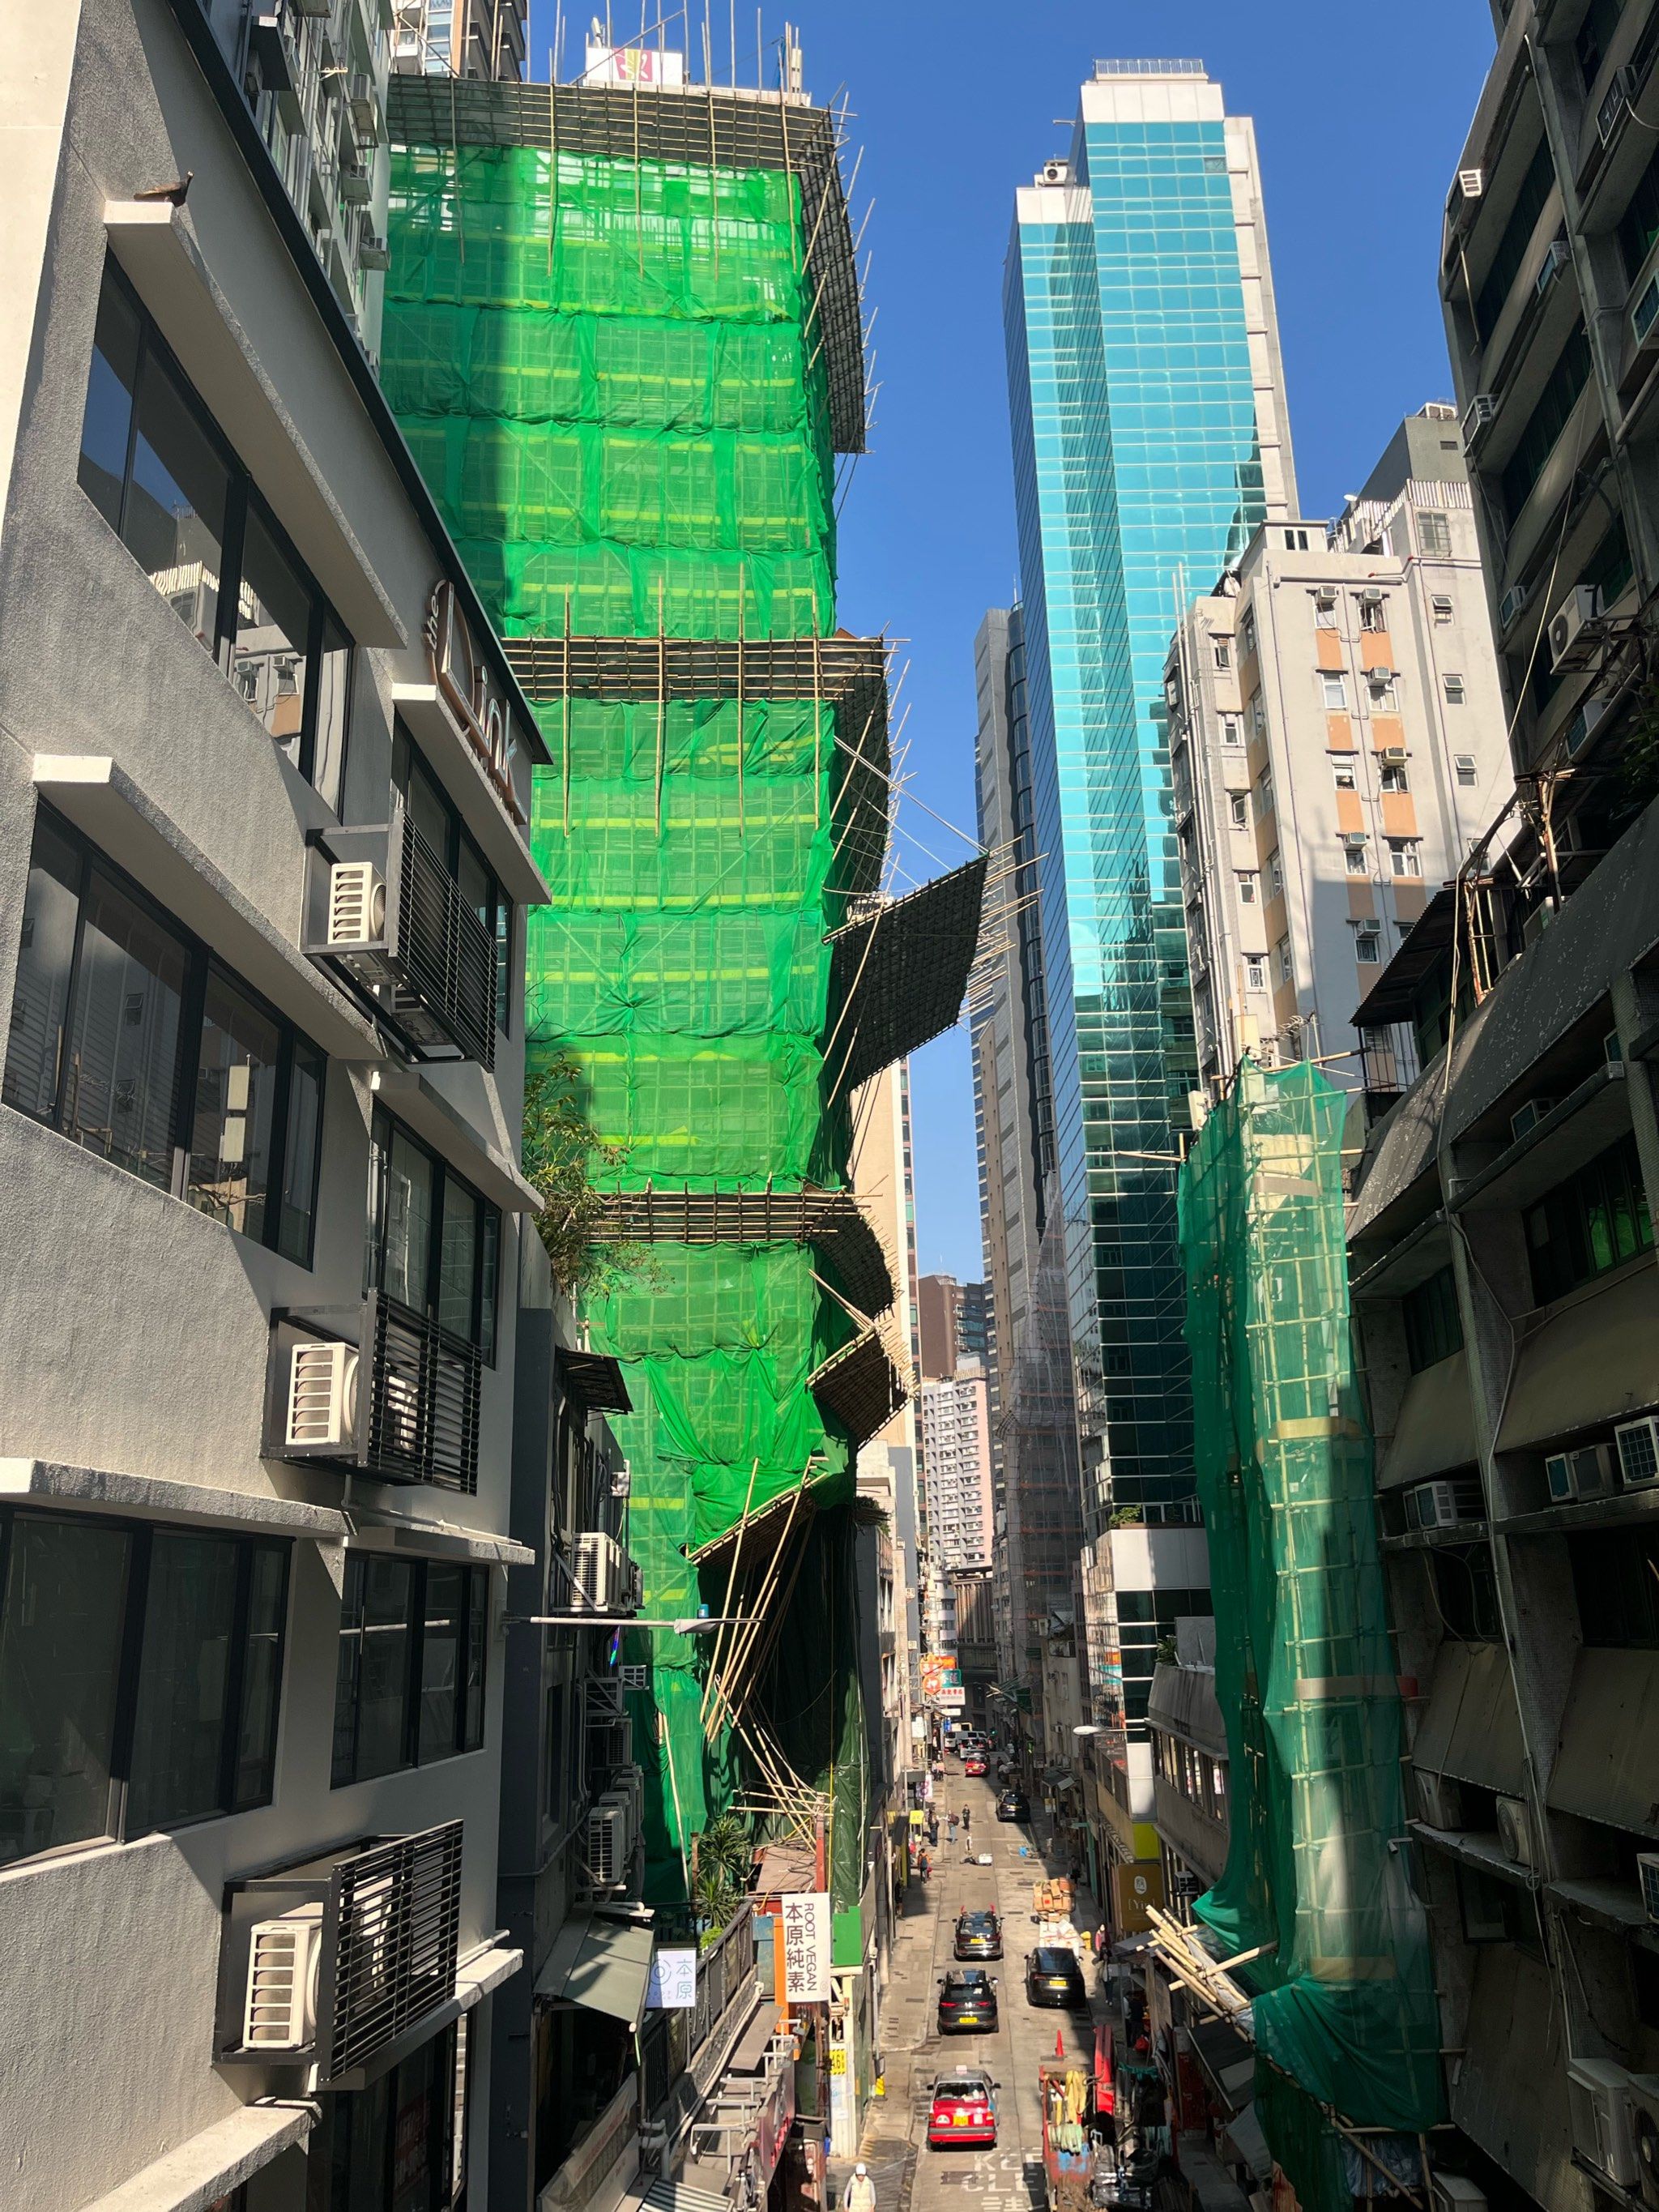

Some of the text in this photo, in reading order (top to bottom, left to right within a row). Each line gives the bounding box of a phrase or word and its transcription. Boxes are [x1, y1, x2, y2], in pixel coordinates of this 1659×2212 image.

[427, 596, 438, 650] the
[785, 1902, 805, 1993] 本原純素
[804, 1902, 817, 1992] ROOT VEGAN
[676, 1958, 693, 2000] 本原
[961, 2172, 1039, 2193] CLE
[974, 2153, 1044, 2171] KEE
